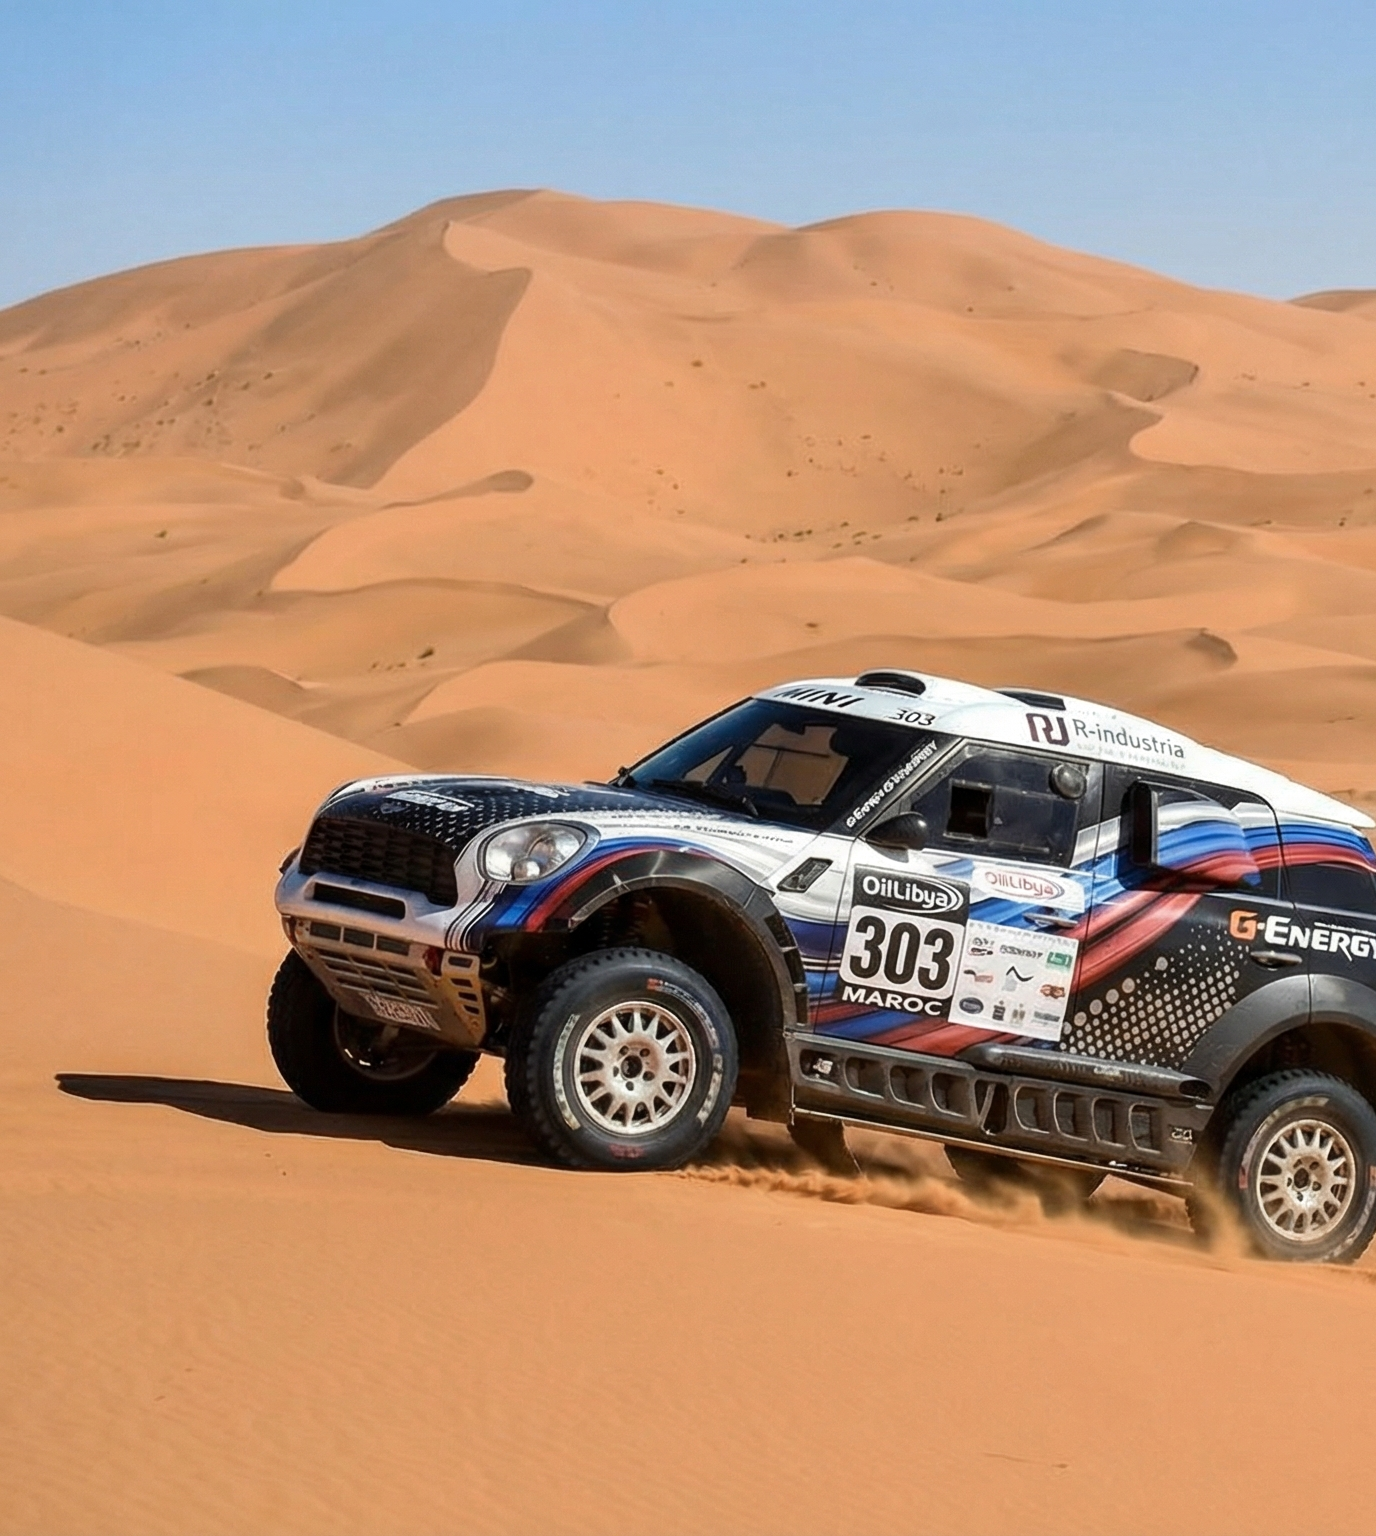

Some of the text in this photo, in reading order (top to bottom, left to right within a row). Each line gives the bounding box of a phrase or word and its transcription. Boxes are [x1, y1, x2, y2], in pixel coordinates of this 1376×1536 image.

[774, 688, 864, 708] MINI
[887, 709, 936, 726] 303
[1072, 718, 1185, 758] R-industria
[862, 875, 949, 908] OilLibya
[850, 915, 954, 990] 303
[842, 986, 943, 1015] MAROC
